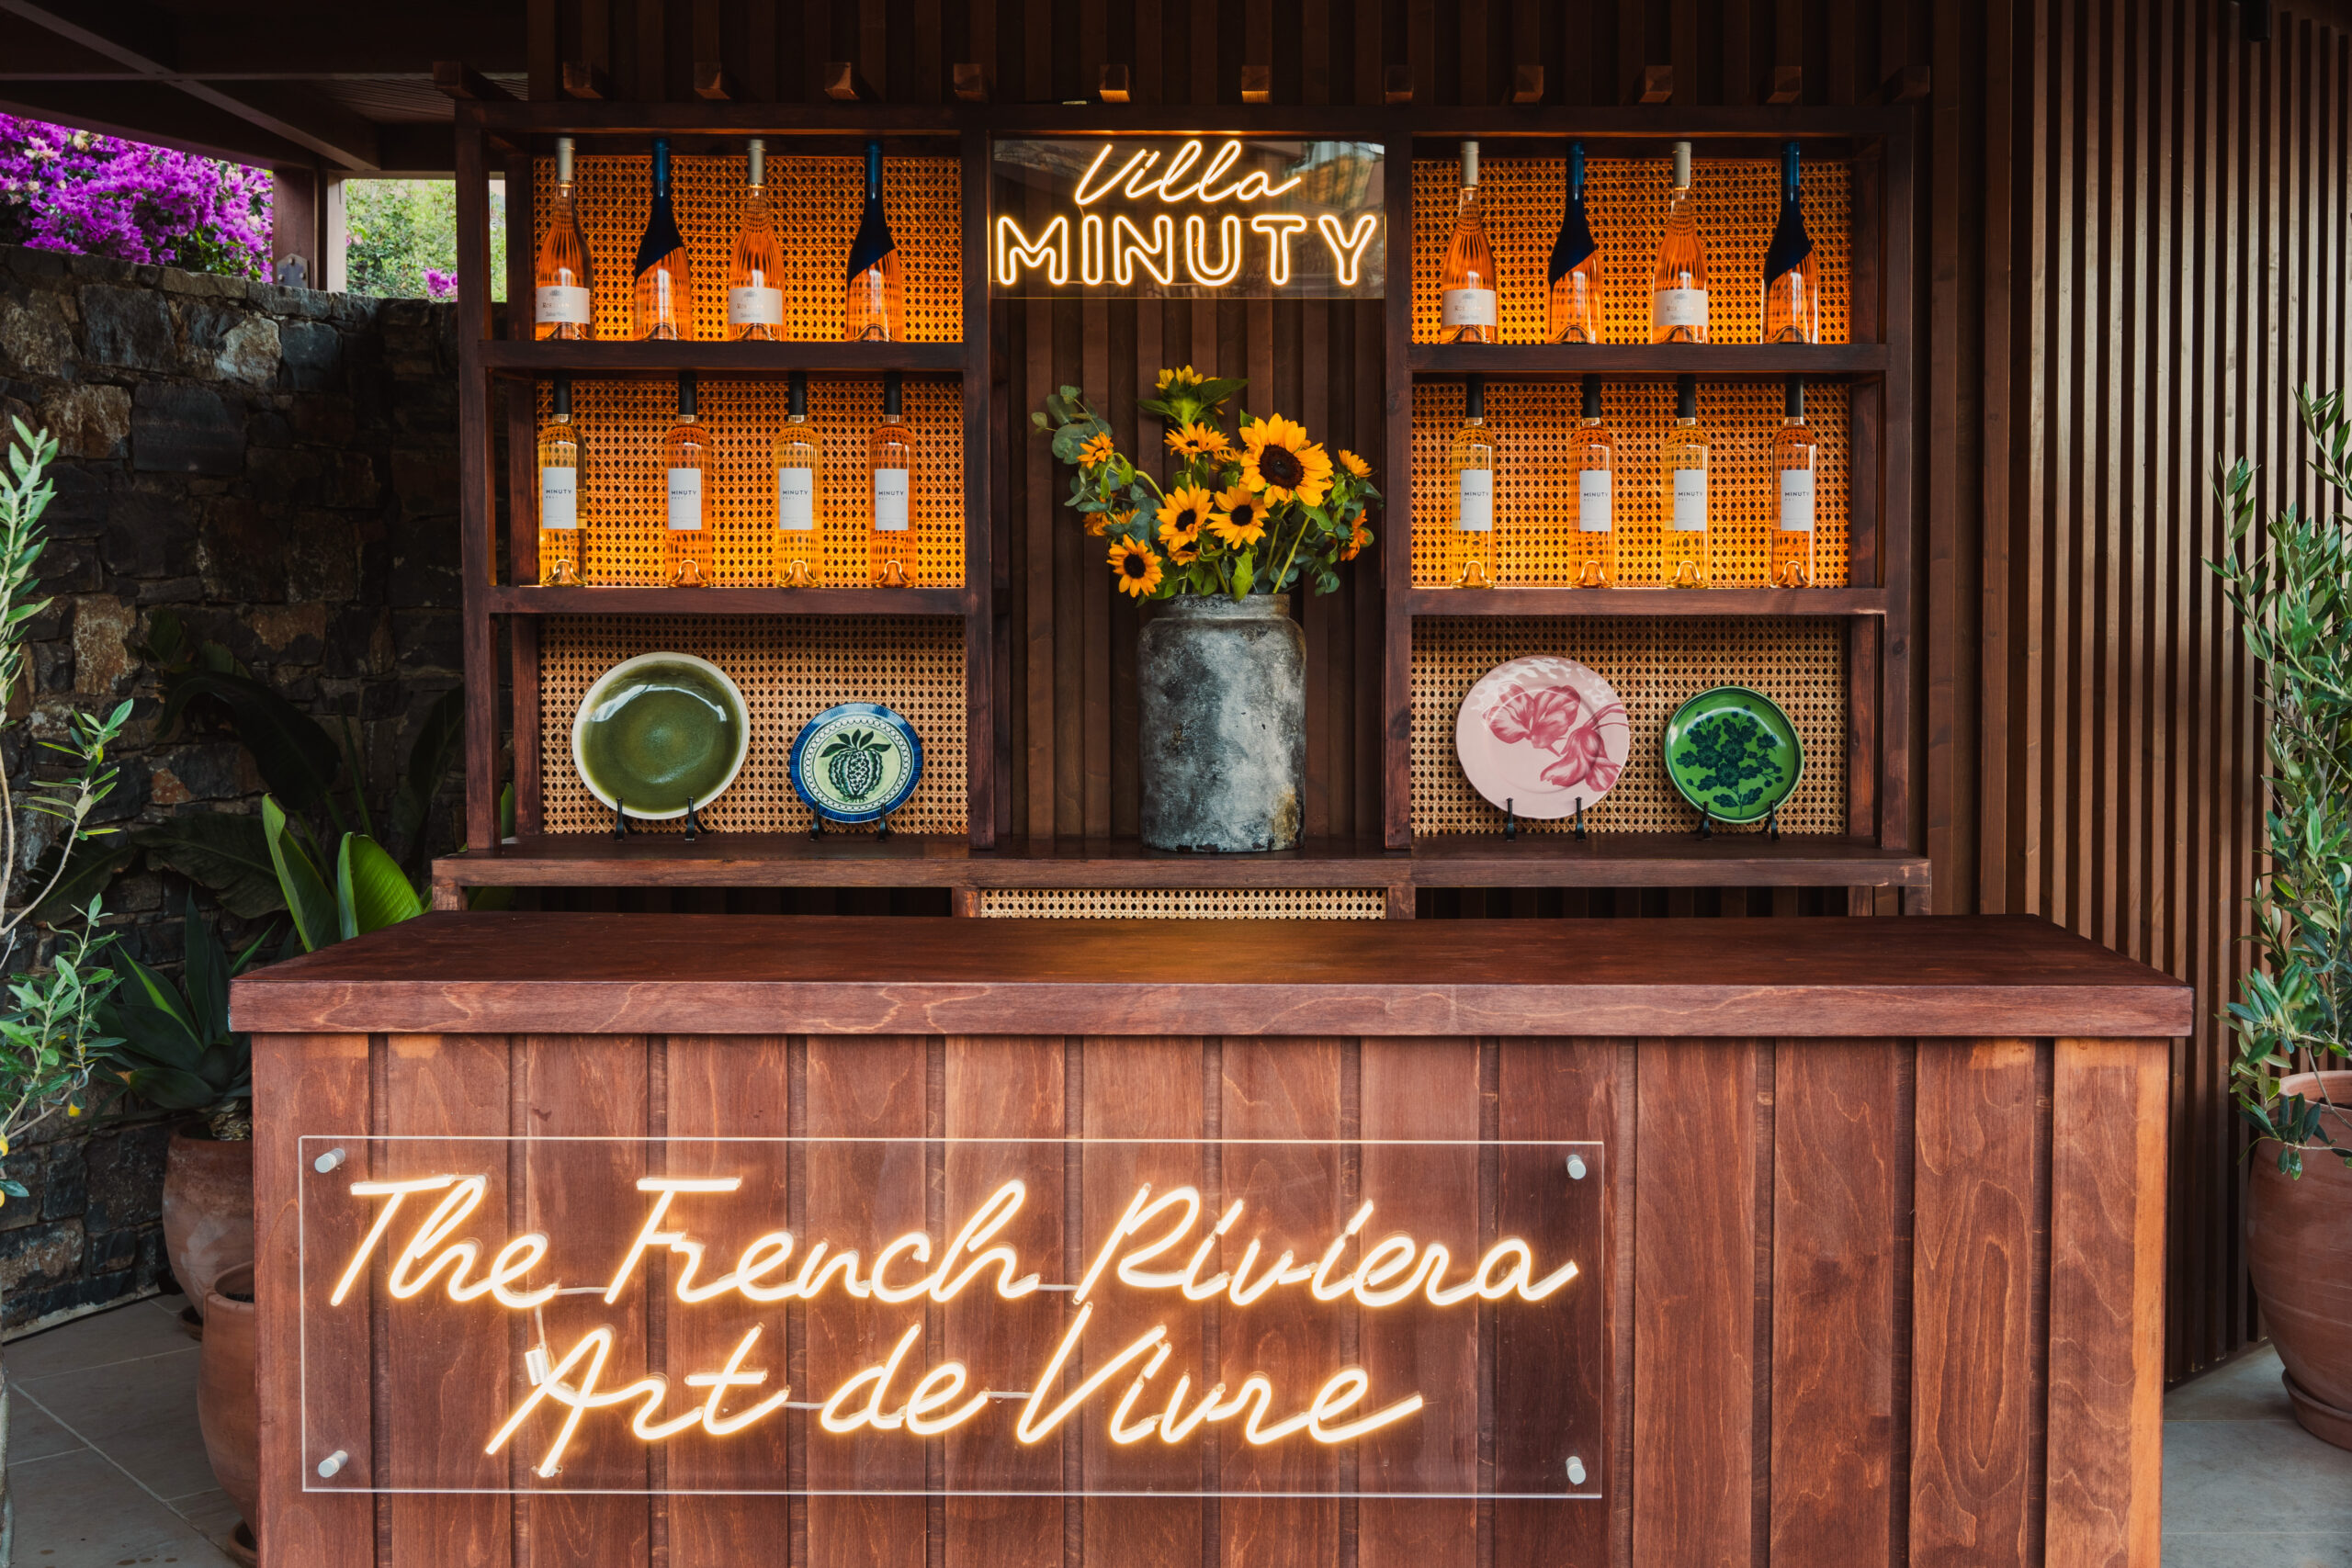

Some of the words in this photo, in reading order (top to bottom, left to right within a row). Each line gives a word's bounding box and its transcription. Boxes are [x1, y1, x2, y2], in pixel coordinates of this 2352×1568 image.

[1074, 140, 1302, 206] Villa
[997, 214, 1377, 287] MINUTY
[331, 1175, 560, 1309] The
[604, 1176, 1040, 1303] French
[1073, 1182, 1579, 1307] Riviera
[486, 1325, 791, 1478] Art
[821, 1323, 992, 1436] de
[1017, 1302, 1423, 1445] Vivre
